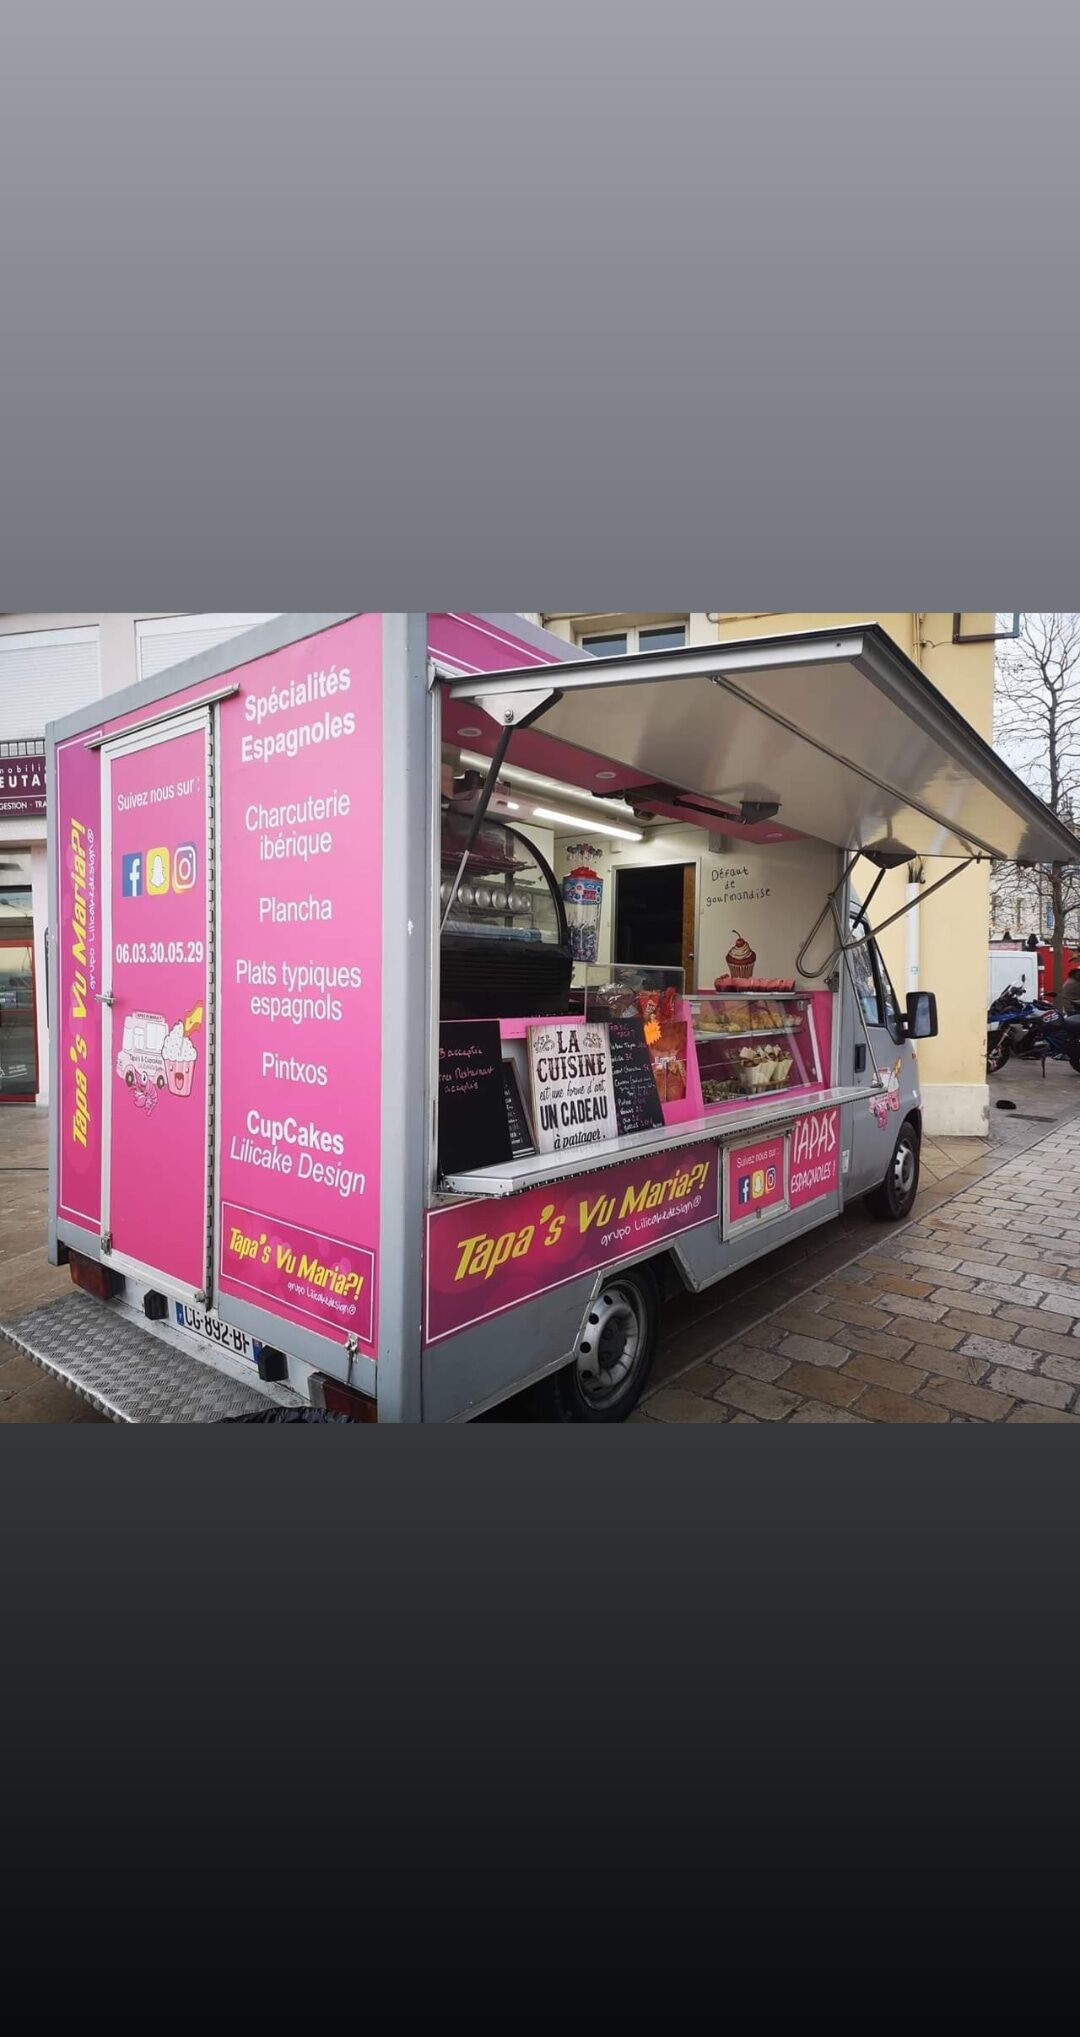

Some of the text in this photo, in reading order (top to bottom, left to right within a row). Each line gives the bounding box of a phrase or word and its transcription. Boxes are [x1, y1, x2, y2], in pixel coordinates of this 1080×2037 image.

[245, 665, 351, 724] Spécialités
[241, 711, 356, 763] Espagnoles
[0, 774, 47, 788] EUTA
[117, 791, 148, 811] Suivez
[149, 783, 175, 804] nous
[176, 778, 195, 797] sur
[245, 789, 351, 832] Charcuterie
[260, 830, 332, 861] ibérique
[711, 866, 749, 881] Défaut
[724, 880, 736, 889] de
[259, 893, 332, 923] Plancha
[706, 888, 771, 907] gourmandise
[116, 940, 203, 963] 06.03.30.05.29
[70, 818, 90, 1147] Tapa's Vu Maria?!
[88, 947, 96, 989] grupo
[236, 959, 362, 993] Plats typiques
[250, 993, 342, 1024] espagnols
[556, 1030, 580, 1054] LA
[262, 1051, 328, 1086] Pintxos
[537, 1053, 606, 1083] CUISINE
[540, 1087, 550, 1100] est
[551, 1088, 564, 1099] une
[566, 1081, 585, 1097] forme
[540, 1103, 558, 1131] UN
[560, 1095, 608, 1127] CADEAU
[247, 1109, 345, 1155] CupCakes
[553, 1133, 562, 1149] à
[793, 1110, 837, 1165] TAPAS
[230, 1135, 366, 1197] Lilicake Design
[736, 1155, 755, 1169] Suivez
[755, 1149, 768, 1162] nous
[791, 1161, 831, 1194] ESPAGNOLES
[454, 1161, 709, 1281] Tapa's Vu Maria?!
[600, 1225, 631, 1246] grupo
[229, 1227, 364, 1301] Tapa's Vu Maria?!
[287, 1281, 306, 1296] grupo
